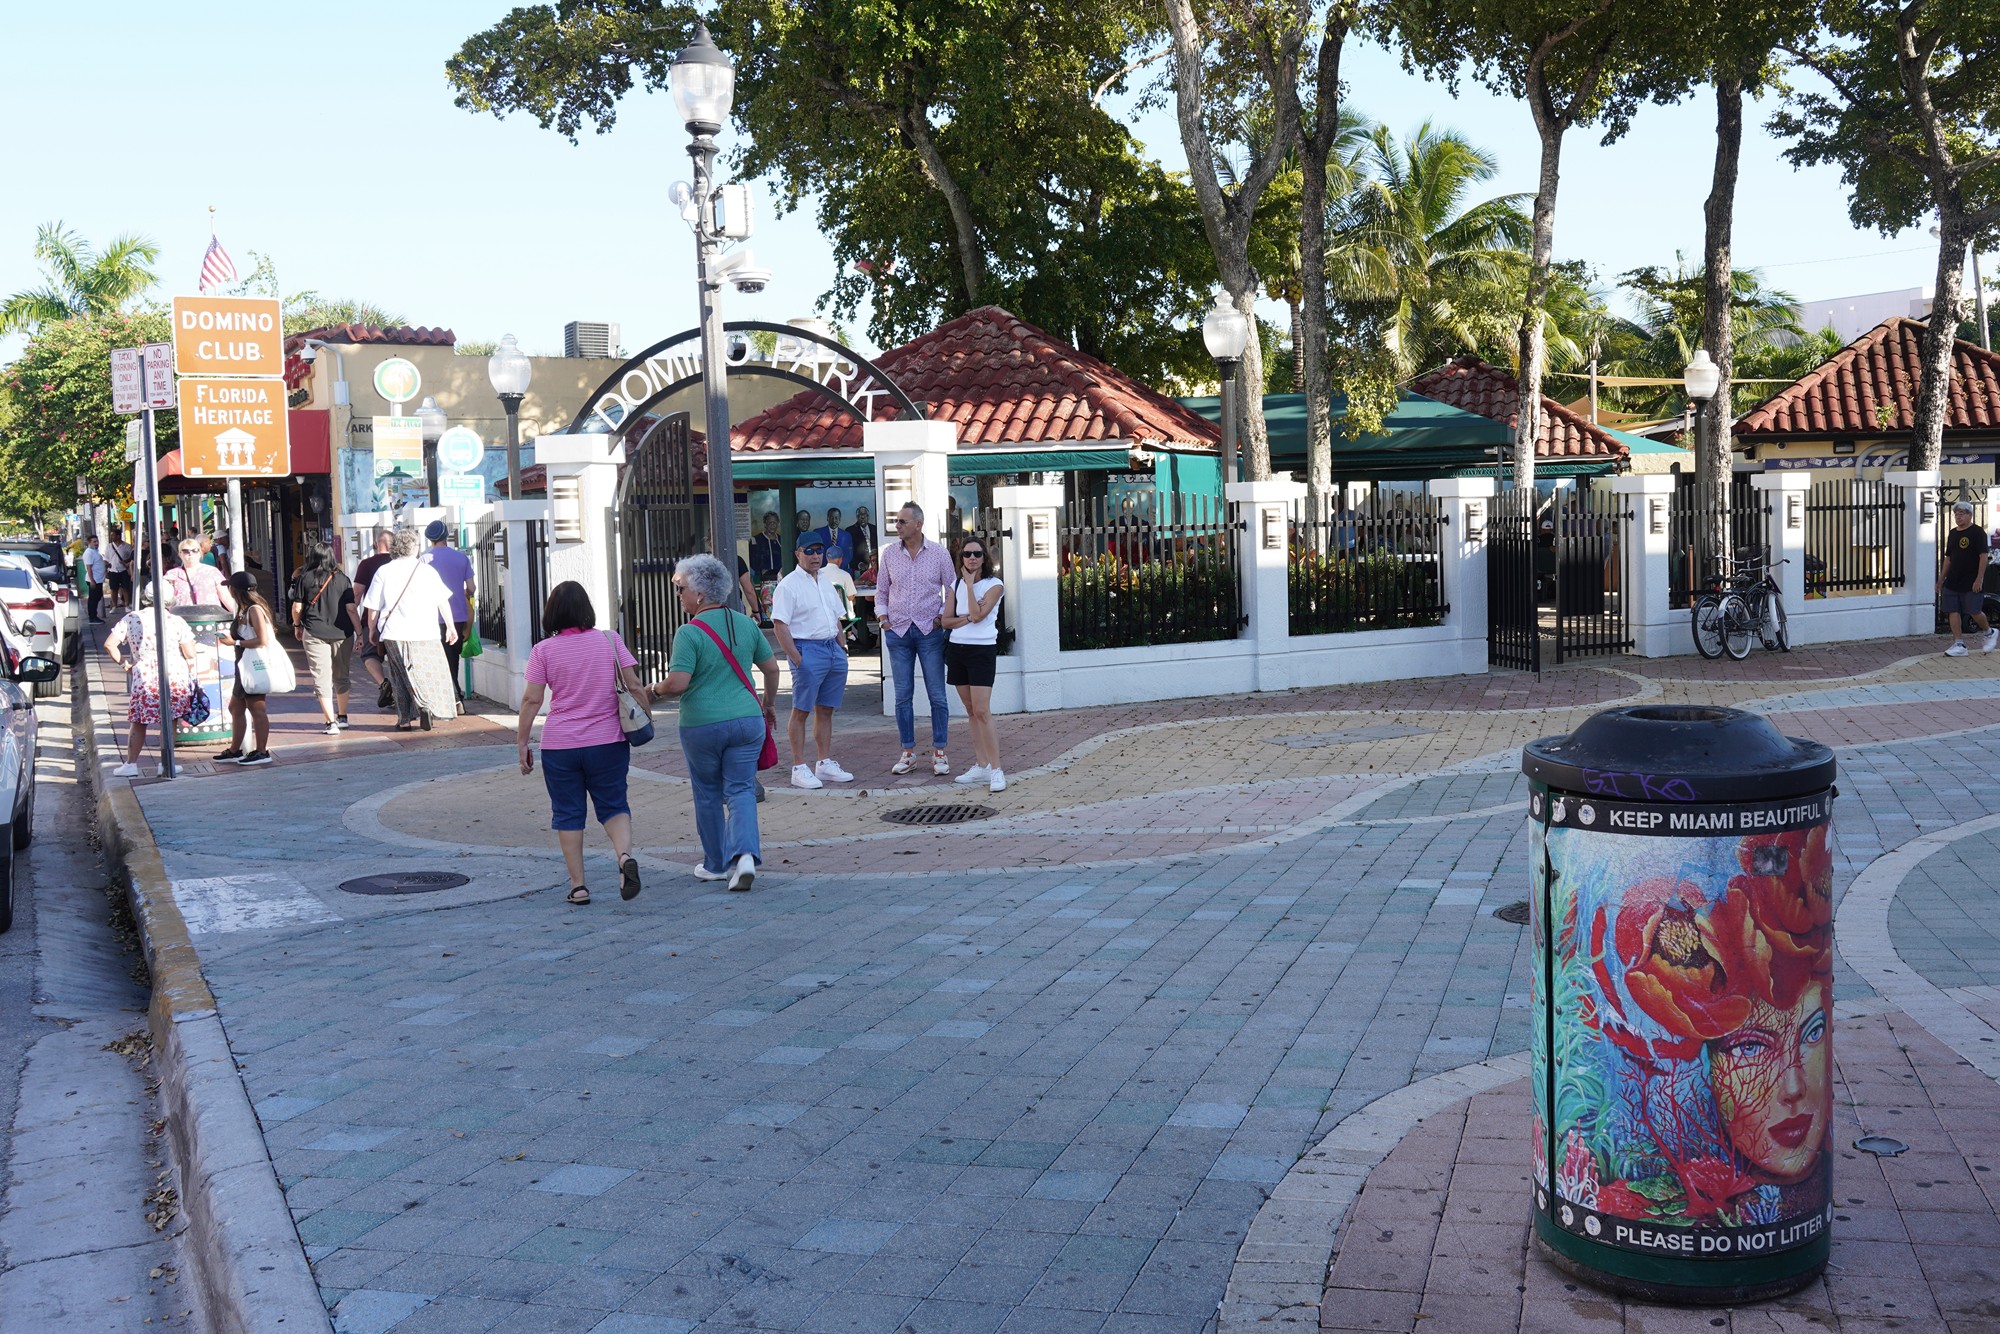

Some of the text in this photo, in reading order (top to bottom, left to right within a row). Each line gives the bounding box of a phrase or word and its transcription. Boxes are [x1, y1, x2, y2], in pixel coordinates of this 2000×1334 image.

[182, 310, 273, 332] DOMINO
[117, 352, 132, 361] TAXI
[153, 348, 162, 359] NO
[198, 341, 260, 361] CLUB
[113, 362, 137, 372] PARKING
[147, 359, 170, 370] PARKING
[119, 373, 132, 382] ONLY
[154, 370, 165, 379] ANY
[771, 333, 890, 422] PARK
[153, 381, 167, 391] TIME
[196, 384, 268, 404] FLORIDA
[194, 406, 273, 425] HERITAGE
[1609, 803, 1821, 830] KEEP MIAMI BEAUTIFUL
[1616, 1214, 1823, 1252] PLEASE DO NOT LITTER
